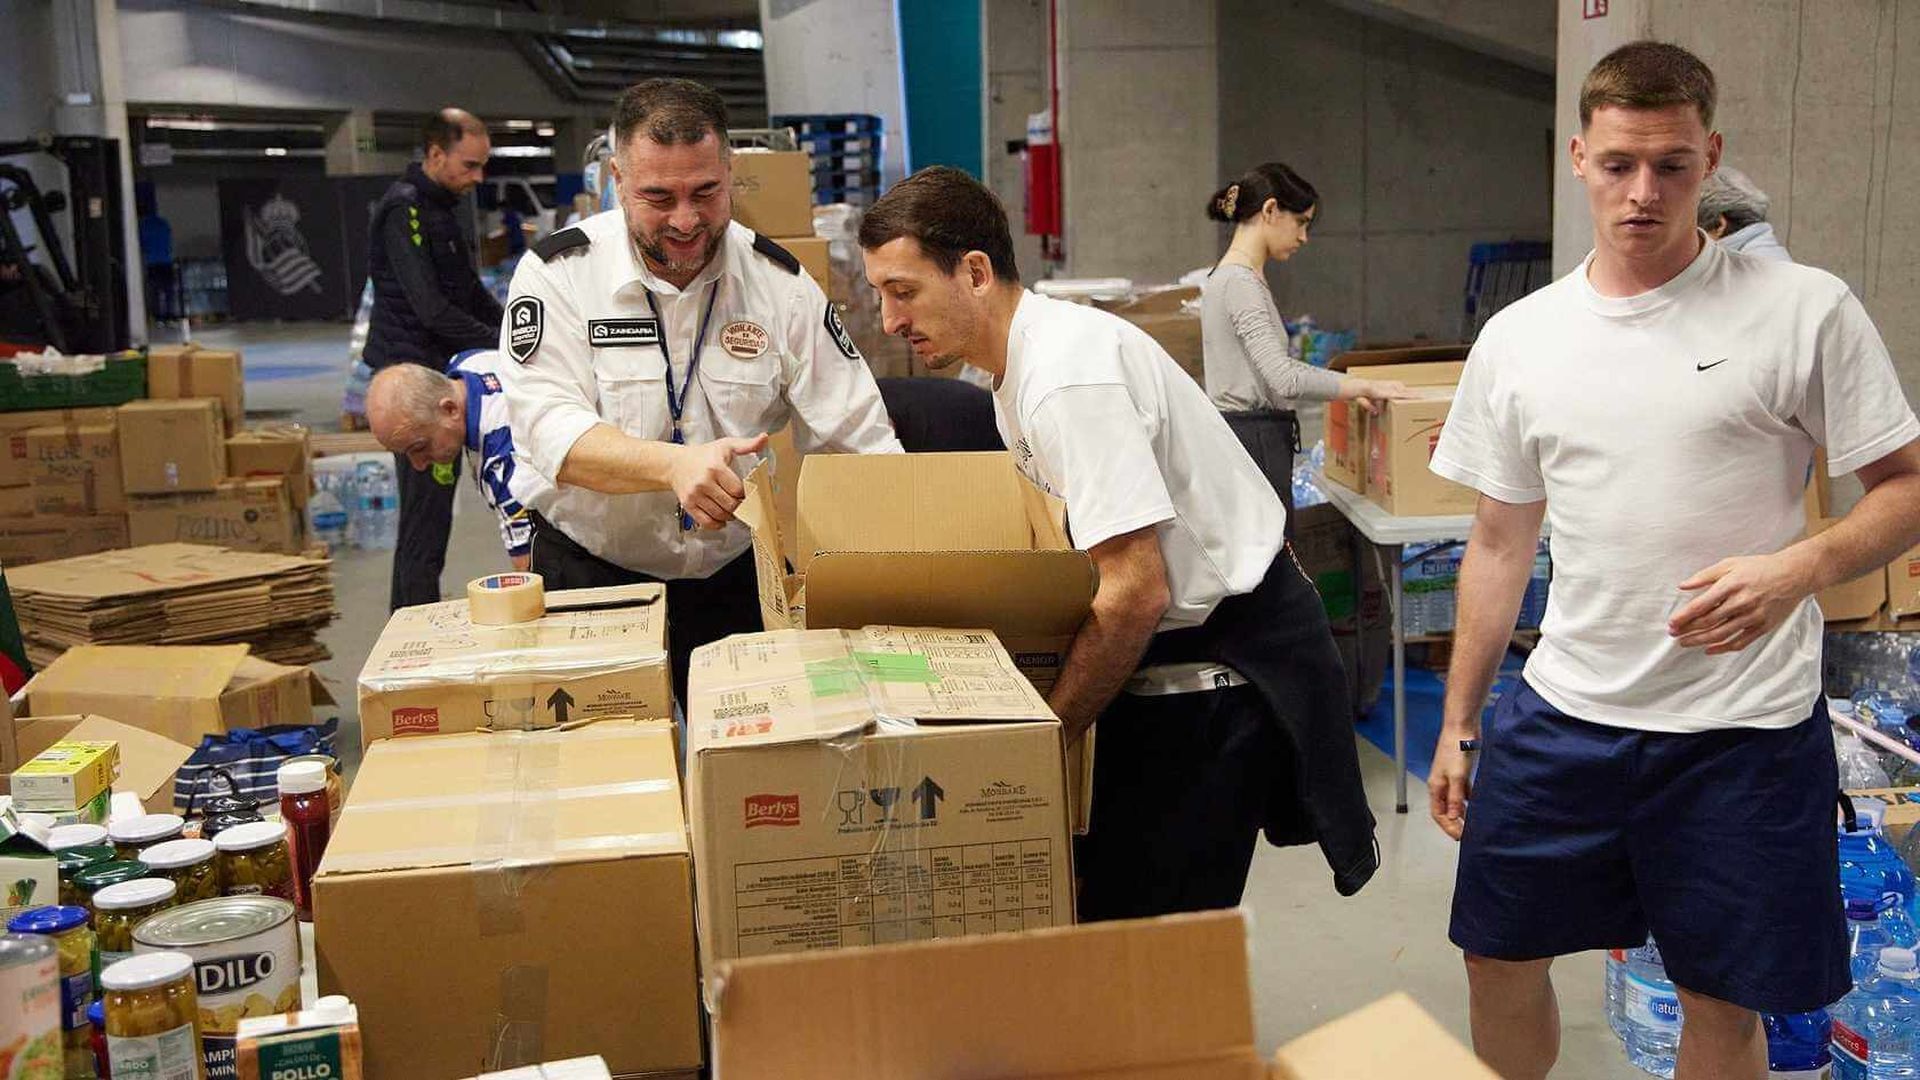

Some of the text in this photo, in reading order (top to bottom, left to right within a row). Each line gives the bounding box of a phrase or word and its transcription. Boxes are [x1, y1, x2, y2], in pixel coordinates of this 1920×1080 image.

[727, 324, 765, 340] VIGILANTE
[724, 336, 765, 349] SEGURIDAD
[394, 712, 437, 727] Berlys
[747, 801, 796, 820] Berlys
[272, 1063, 331, 1080] POLLO
